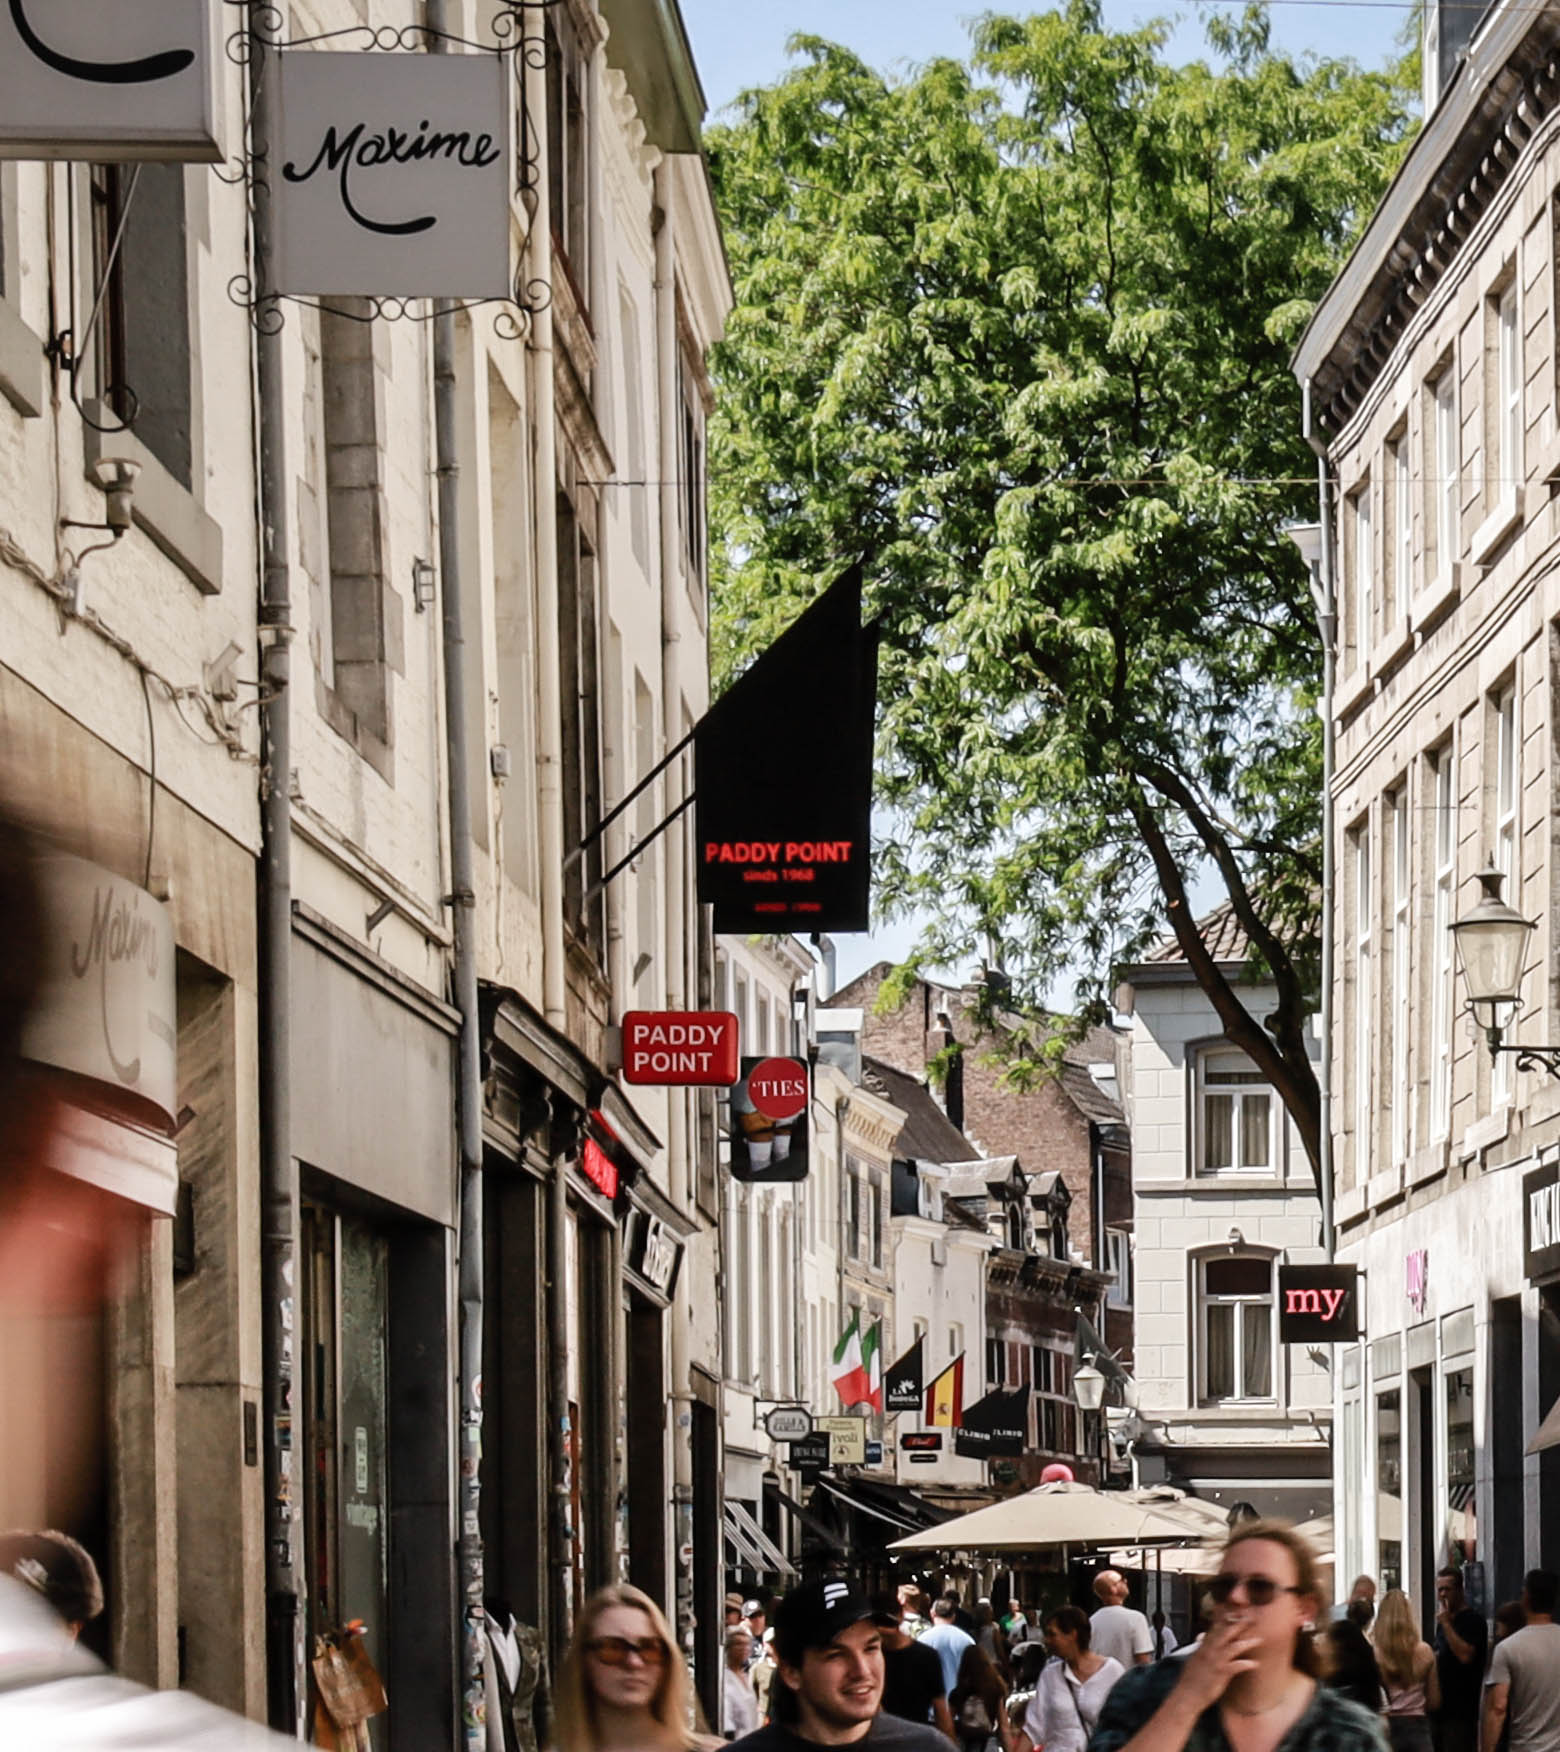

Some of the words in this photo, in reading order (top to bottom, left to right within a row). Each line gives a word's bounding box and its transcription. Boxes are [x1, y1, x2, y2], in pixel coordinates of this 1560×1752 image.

[283, 119, 500, 235] Maxime
[705, 842, 781, 863] PADDY
[785, 841, 852, 863] POINT
[634, 1024, 724, 1047] PADDY
[634, 1052, 713, 1073] POINT
[1286, 1284, 1344, 1320] my
